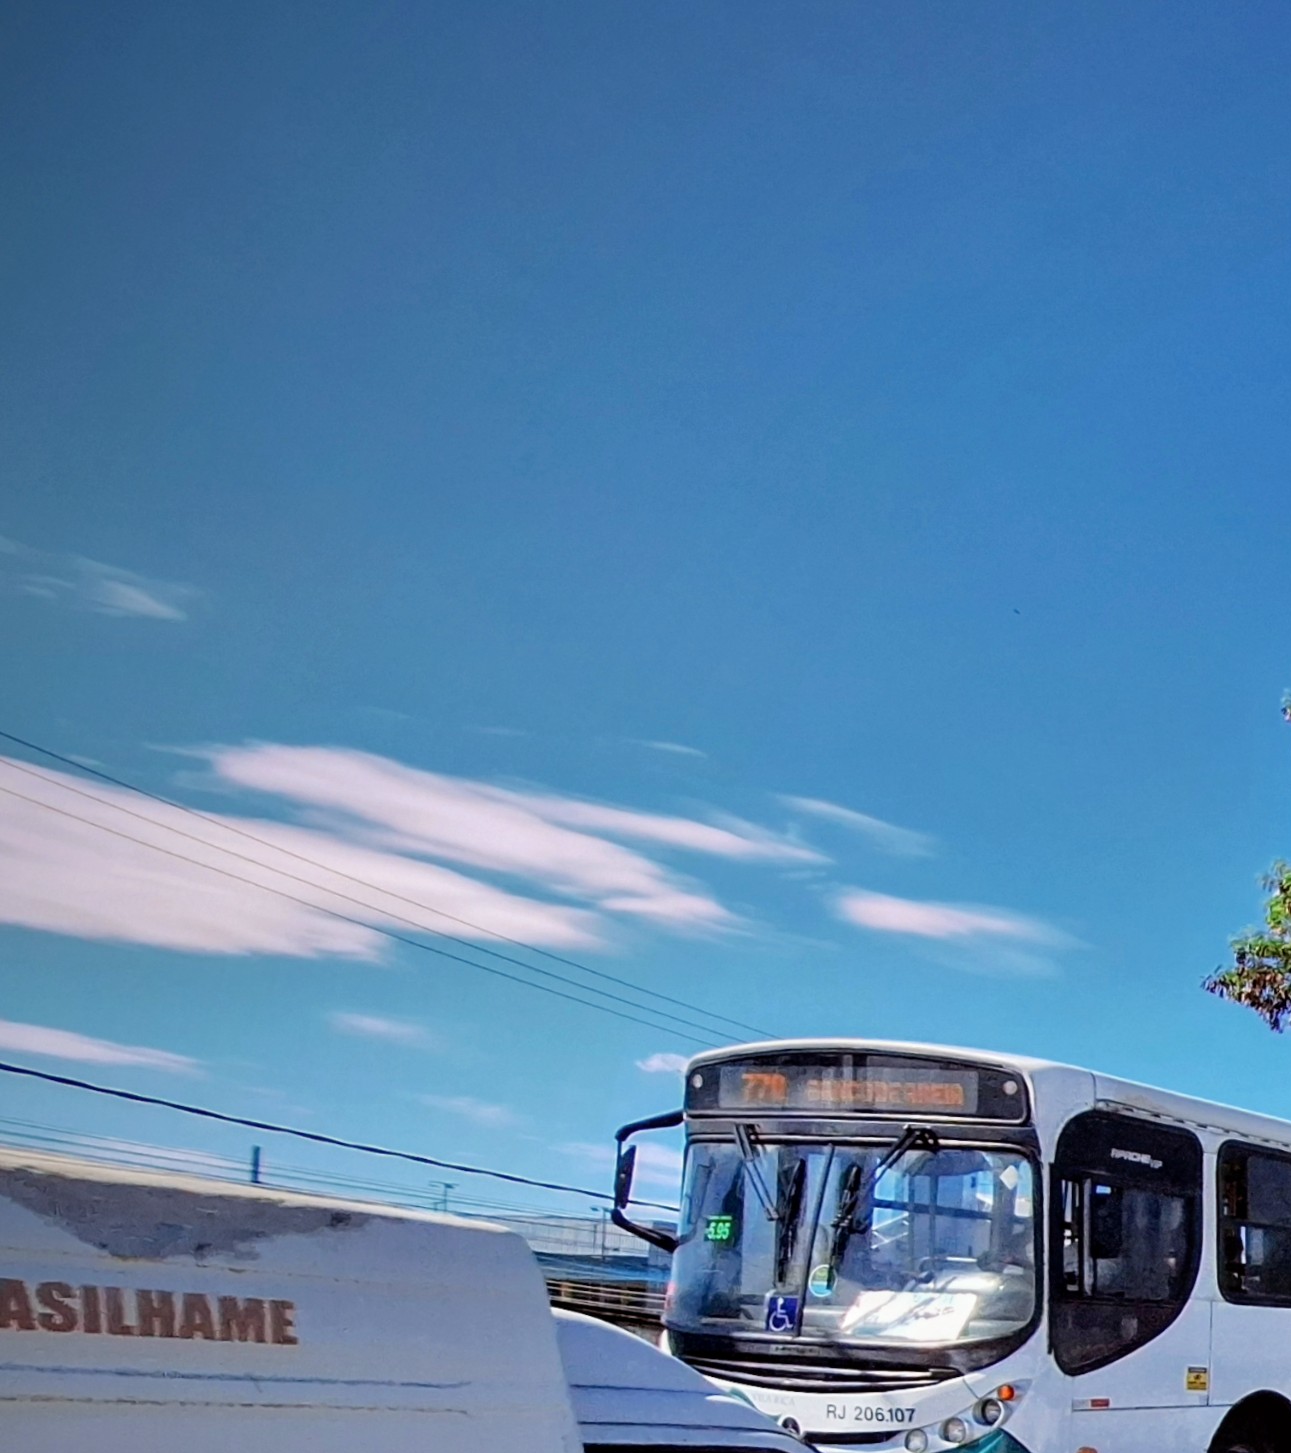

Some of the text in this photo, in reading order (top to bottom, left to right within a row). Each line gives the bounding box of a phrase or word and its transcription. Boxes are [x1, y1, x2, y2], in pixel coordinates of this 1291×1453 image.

[0, 1277, 298, 1345] ASILHAME
[826, 1404, 916, 1423] RJ 206.107
